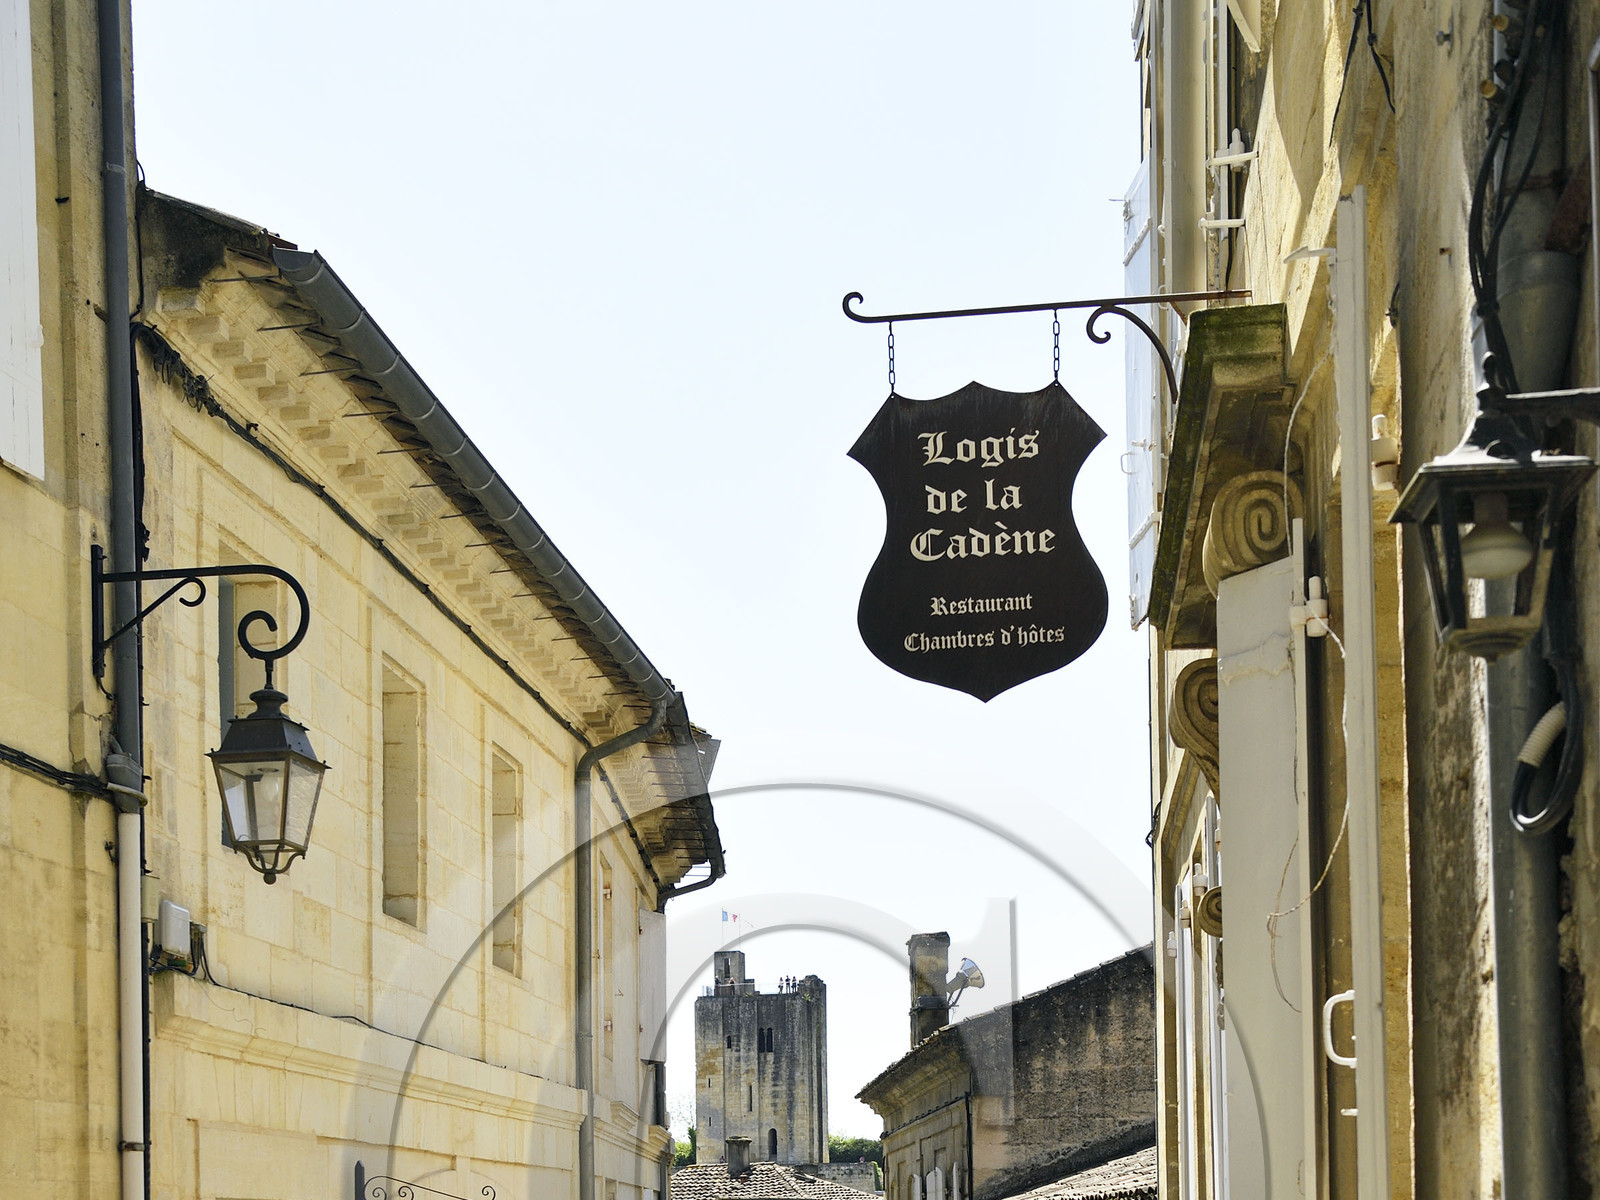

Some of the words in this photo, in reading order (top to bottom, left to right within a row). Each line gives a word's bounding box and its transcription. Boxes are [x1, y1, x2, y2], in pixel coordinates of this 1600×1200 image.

[917, 427, 1040, 468] Logis
[924, 485, 968, 515] de
[984, 479, 1023, 510] la
[910, 521, 1056, 562] Cadène
[930, 594, 1033, 616] Restaurant
[904, 630, 996, 654] Chambres
[1000, 624, 1065, 648] d'hôtes
